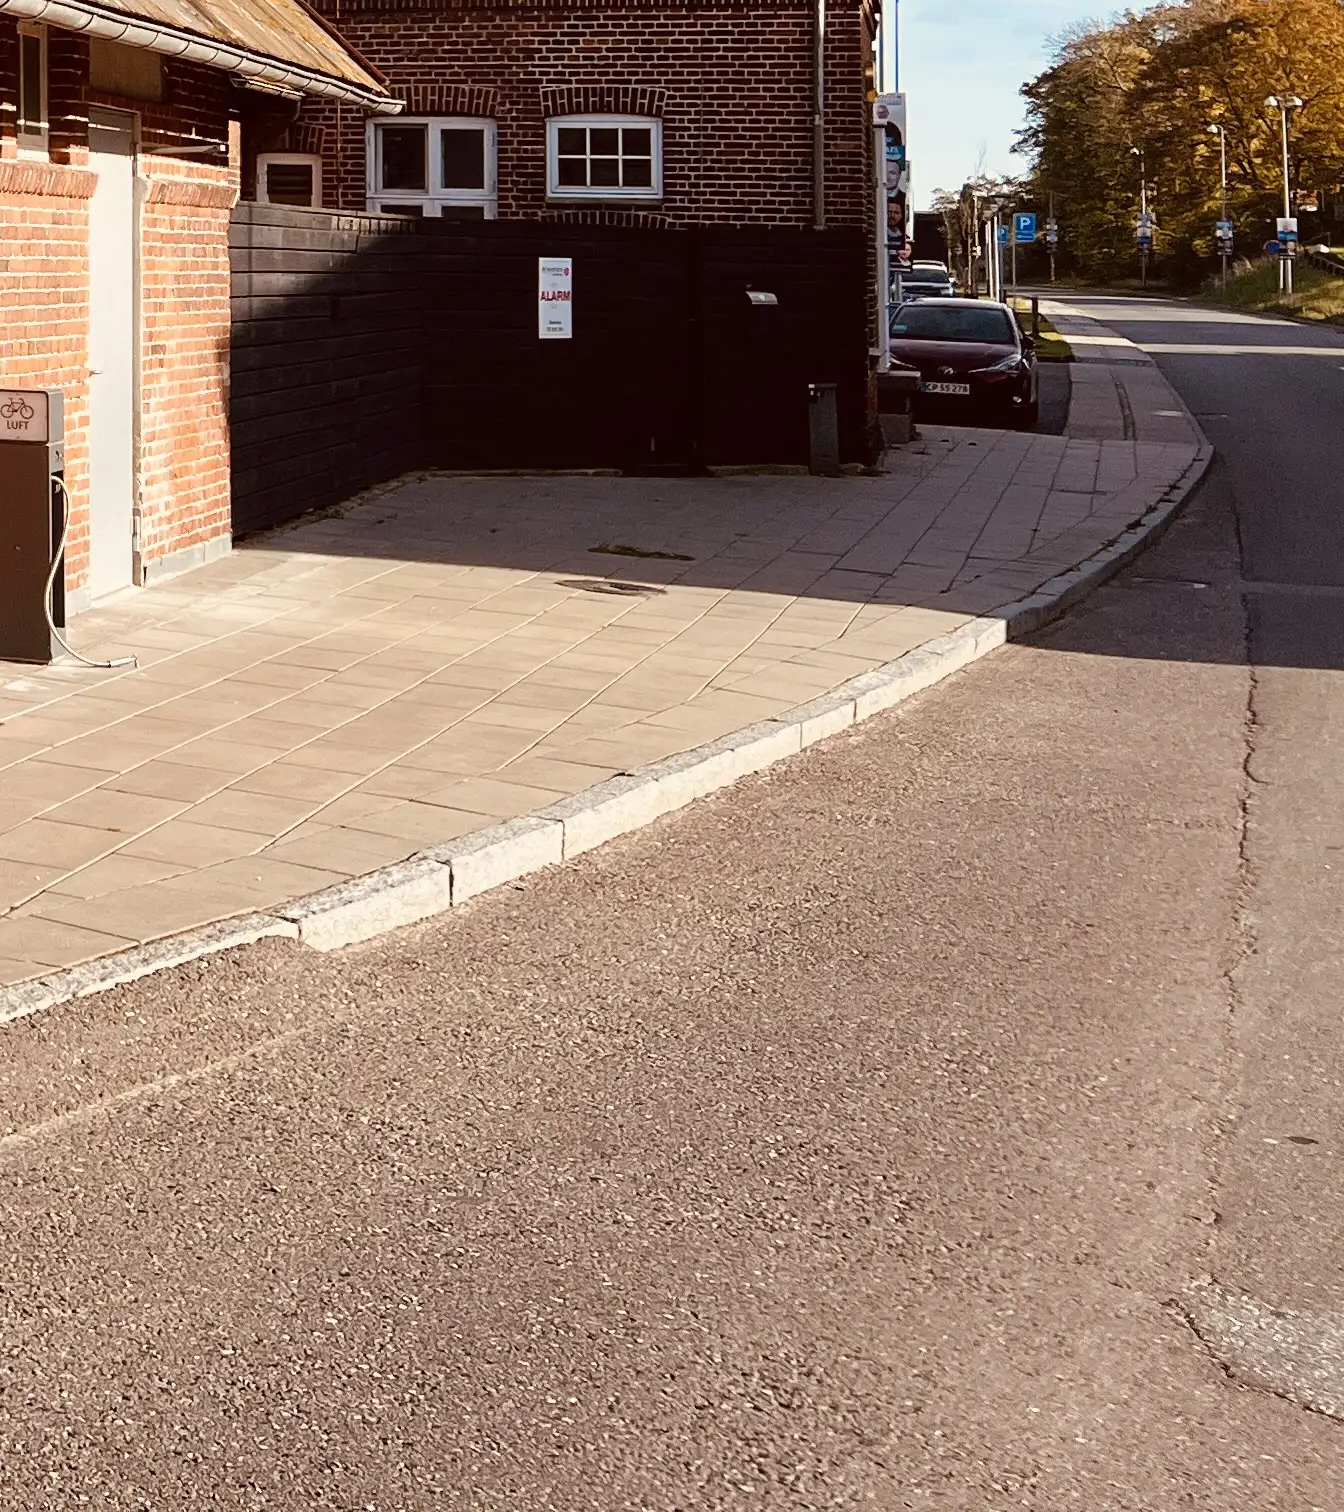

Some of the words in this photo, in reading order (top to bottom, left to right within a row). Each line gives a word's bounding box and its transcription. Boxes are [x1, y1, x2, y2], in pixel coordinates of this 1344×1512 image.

[1020, 216, 1031, 230] P
[540, 290, 571, 301] ALARM
[6, 420, 29, 430] LUFT
